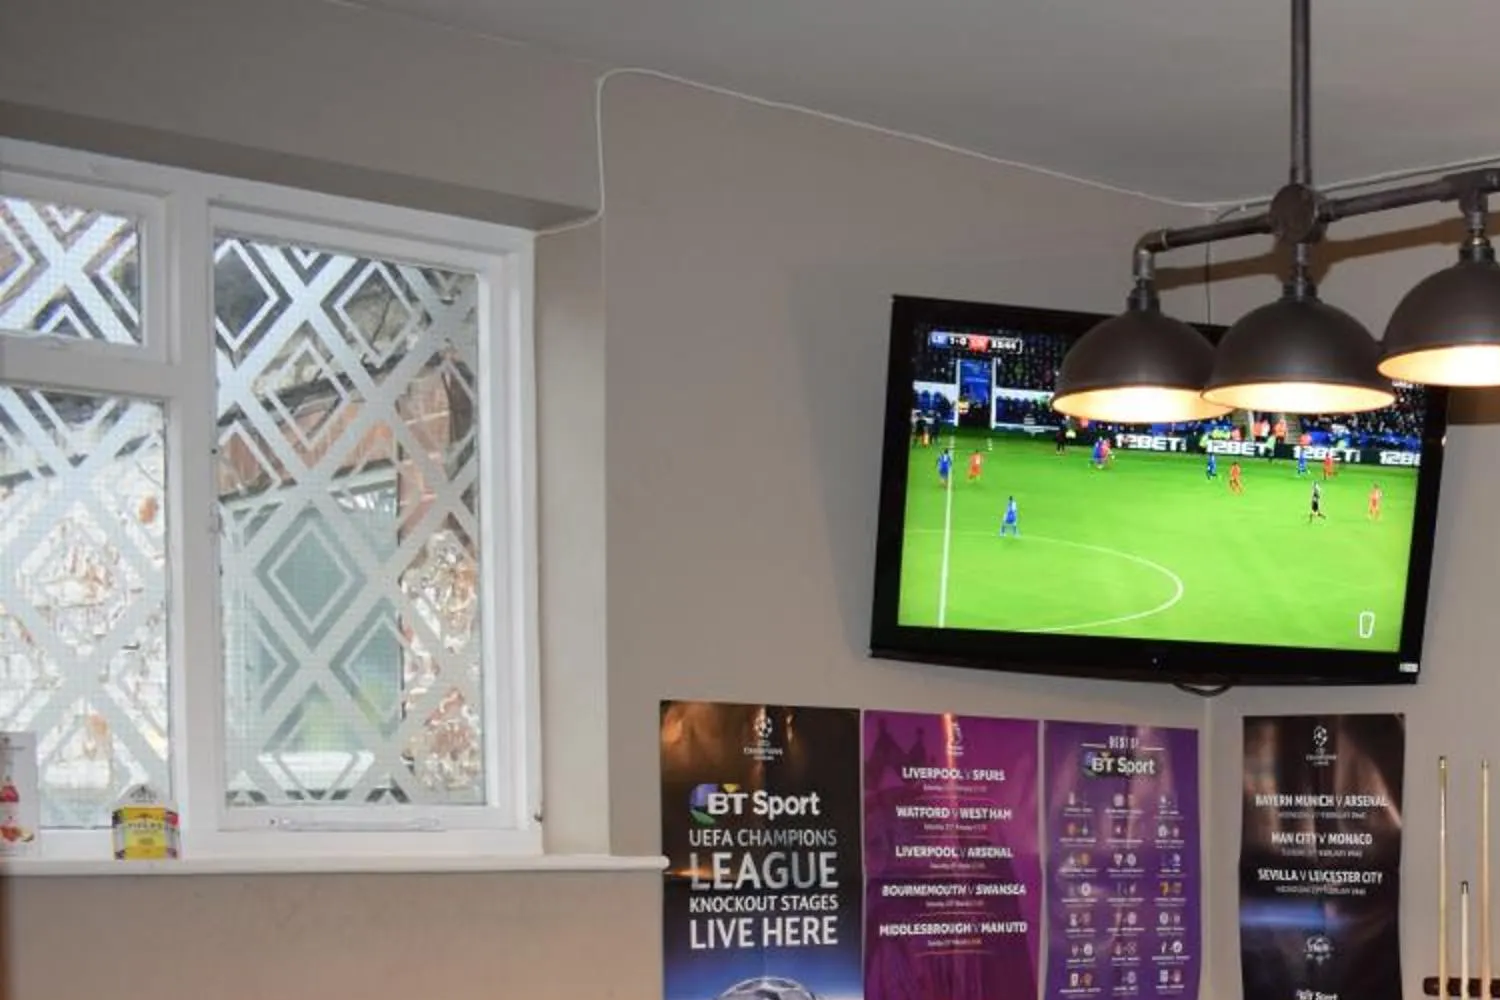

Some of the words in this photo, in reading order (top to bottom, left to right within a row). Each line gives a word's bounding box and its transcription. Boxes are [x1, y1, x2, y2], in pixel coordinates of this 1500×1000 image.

[902, 766, 963, 780] LIVERPOOL
[972, 769, 1006, 781] SPURS
[1092, 757, 1114, 773] BT
[1117, 757, 1156, 776] Sport
[707, 793, 748, 815] BT
[752, 789, 821, 821] Sport
[1255, 795, 1293, 807] BAYERN
[1295, 795, 1335, 807] MUNICH
[1344, 795, 1388, 807] ARSENAL
[896, 805, 950, 818] WATFORD
[960, 807, 989, 819] WEST
[990, 808, 1013, 820] HAM
[689, 829, 733, 846] UEFA
[737, 829, 838, 846] CHAMPIONS
[1271, 832, 1294, 843] MAN
[1296, 833, 1317, 843] CITY
[1328, 833, 1373, 845] MONACO
[895, 845, 958, 858] LIVERPOOL
[968, 847, 1014, 858] ARSENAL
[689, 852, 840, 890] LEAGUE
[1258, 868, 1298, 881] SEVILLA
[1308, 870, 1361, 883] LEICESTER
[1362, 871, 1383, 884] CITY
[882, 884, 966, 897] BOURNEMOUTH
[976, 884, 1027, 896] SWANSEA
[690, 894, 777, 912] KNOCKOUT
[781, 893, 839, 911] STAGES
[690, 917, 755, 949] LIVE
[763, 915, 839, 947] HERE
[879, 922, 971, 936] MIDDLESBROUGH
[981, 922, 1006, 934] MAN
[1006, 921, 1028, 933] UTD
